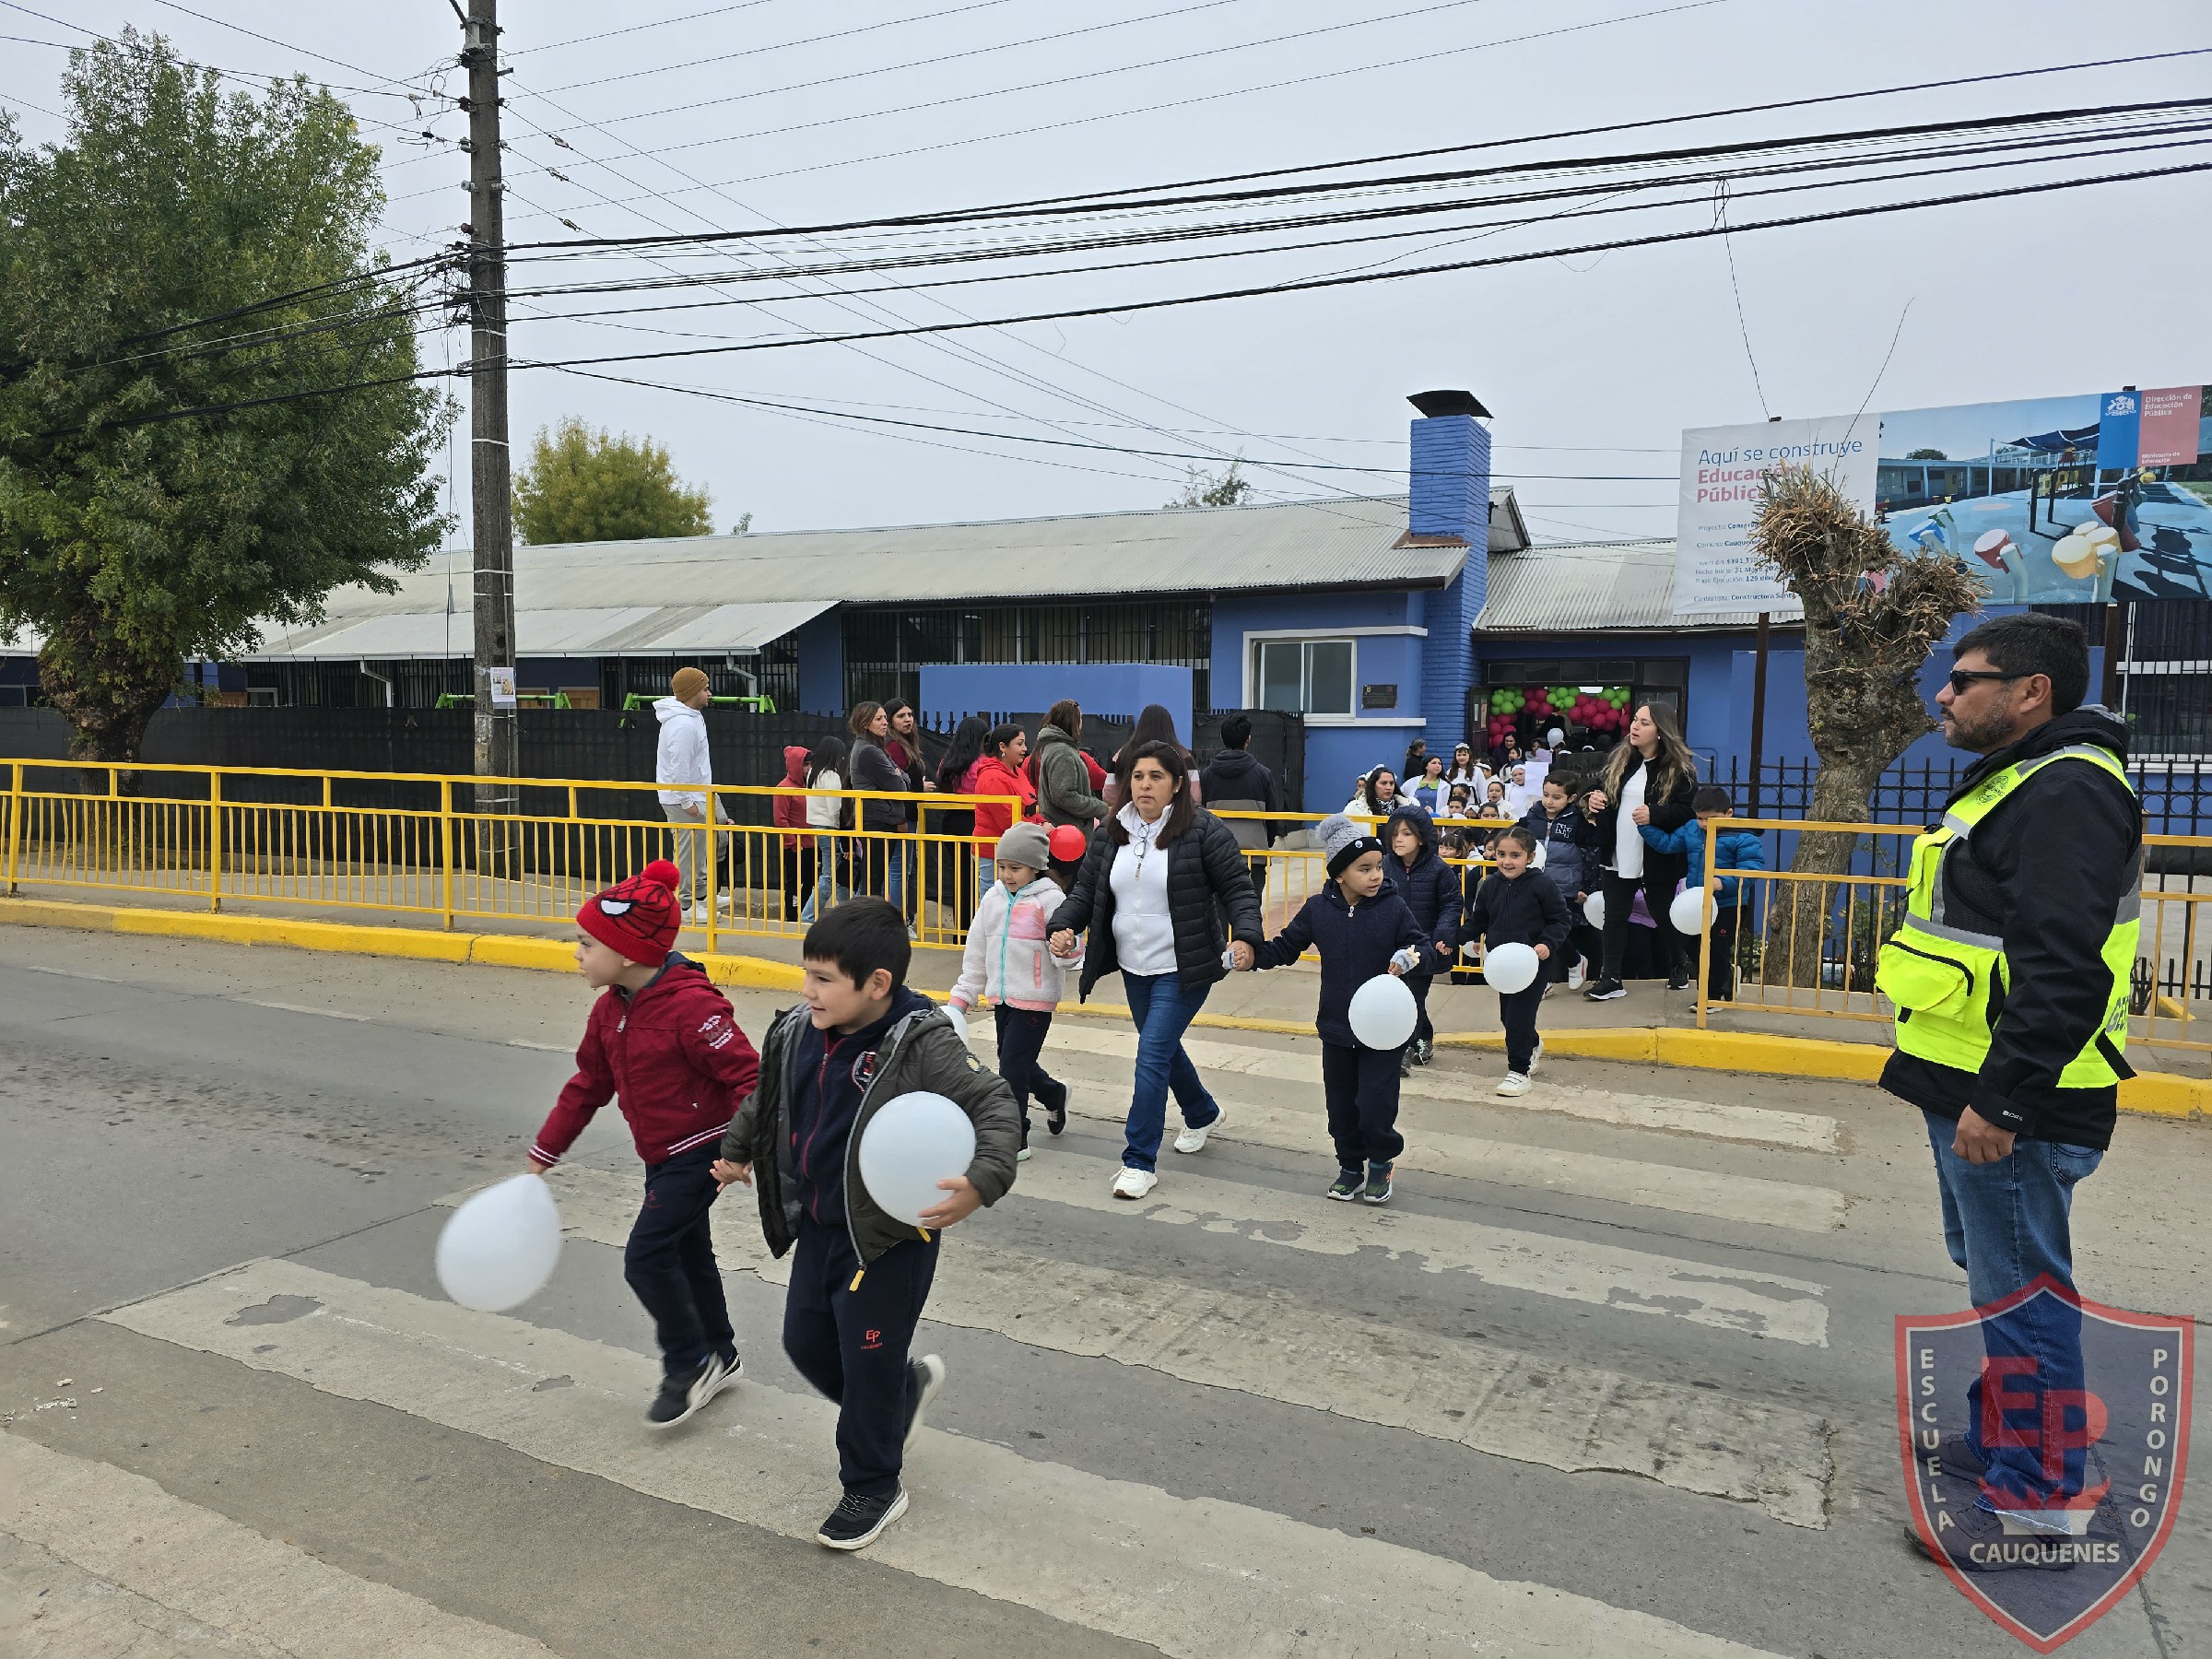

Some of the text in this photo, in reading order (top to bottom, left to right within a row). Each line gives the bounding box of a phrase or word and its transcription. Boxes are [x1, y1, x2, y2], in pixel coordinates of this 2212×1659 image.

[2146, 394, 2182, 403] Dirección
[2145, 402, 2183, 410] Educación
[1699, 440, 1863, 467] Aquí se construye
[1556, 823, 1573, 839] NY
[866, 1329, 881, 1343] EP
